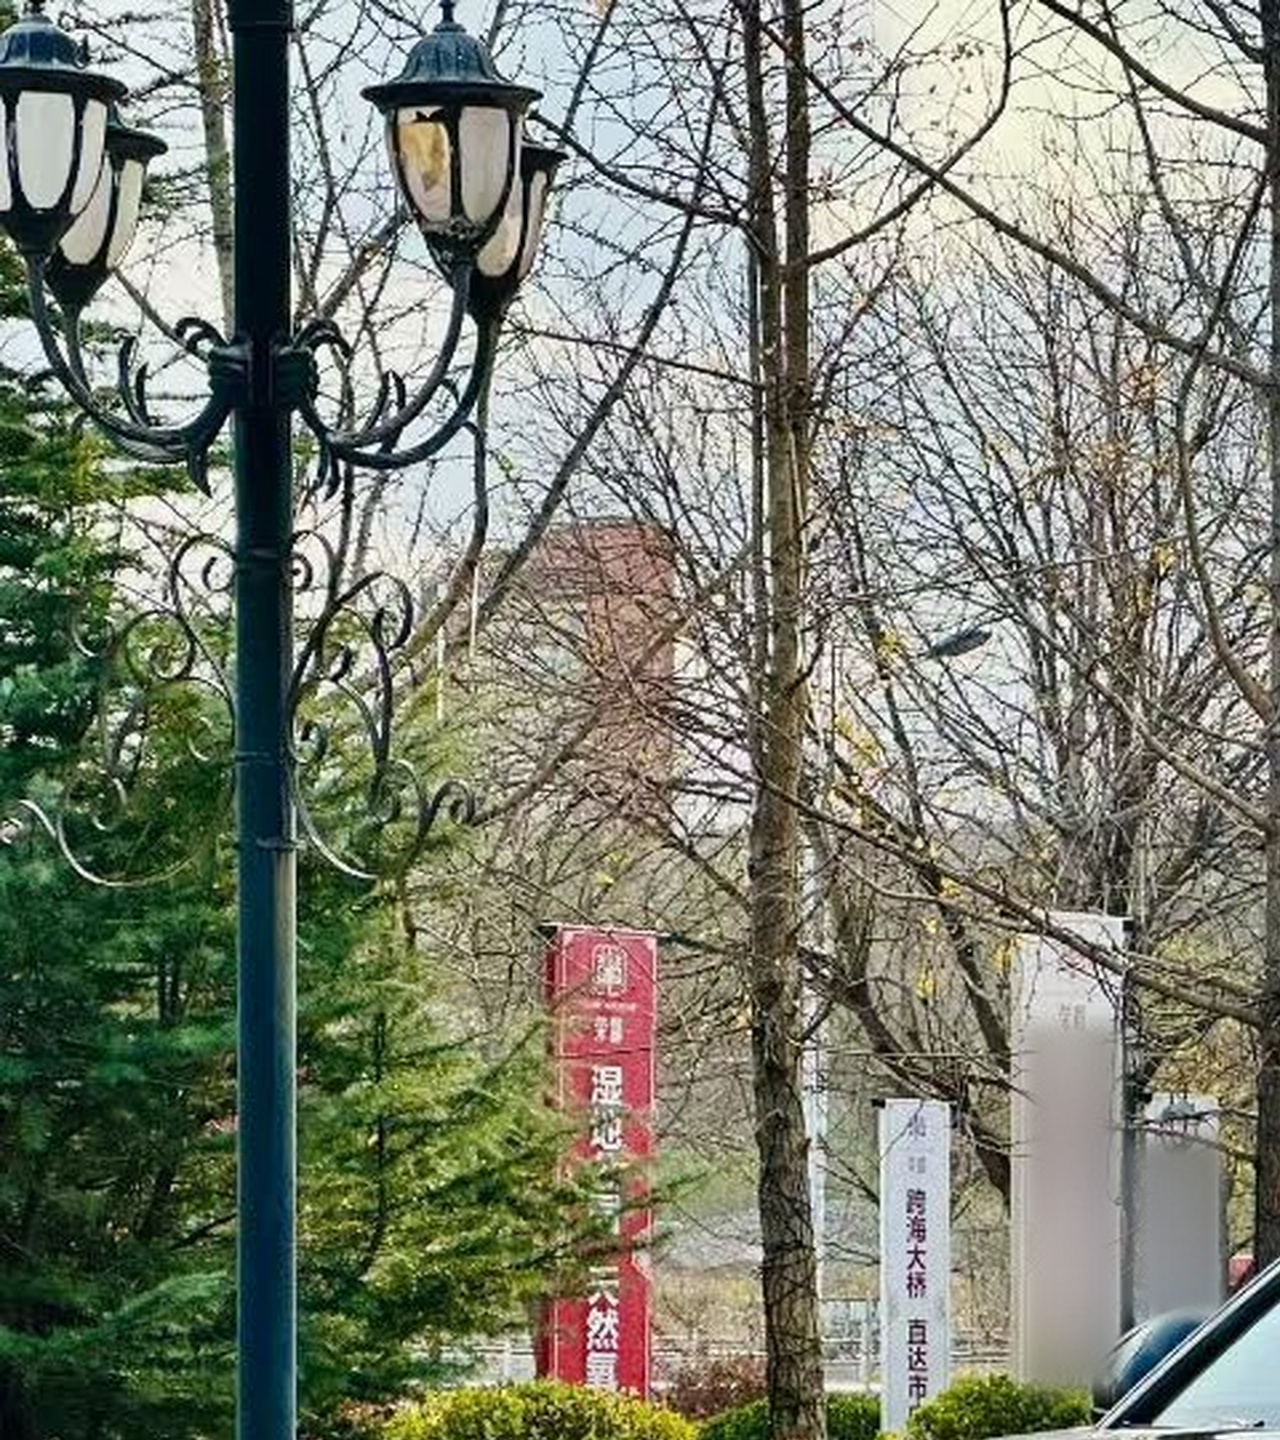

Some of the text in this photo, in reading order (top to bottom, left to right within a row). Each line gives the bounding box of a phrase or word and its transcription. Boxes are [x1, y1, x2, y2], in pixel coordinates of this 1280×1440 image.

[905, 1187, 927, 1299] 跨海大桥
[906, 1317, 929, 1417] 直达市
